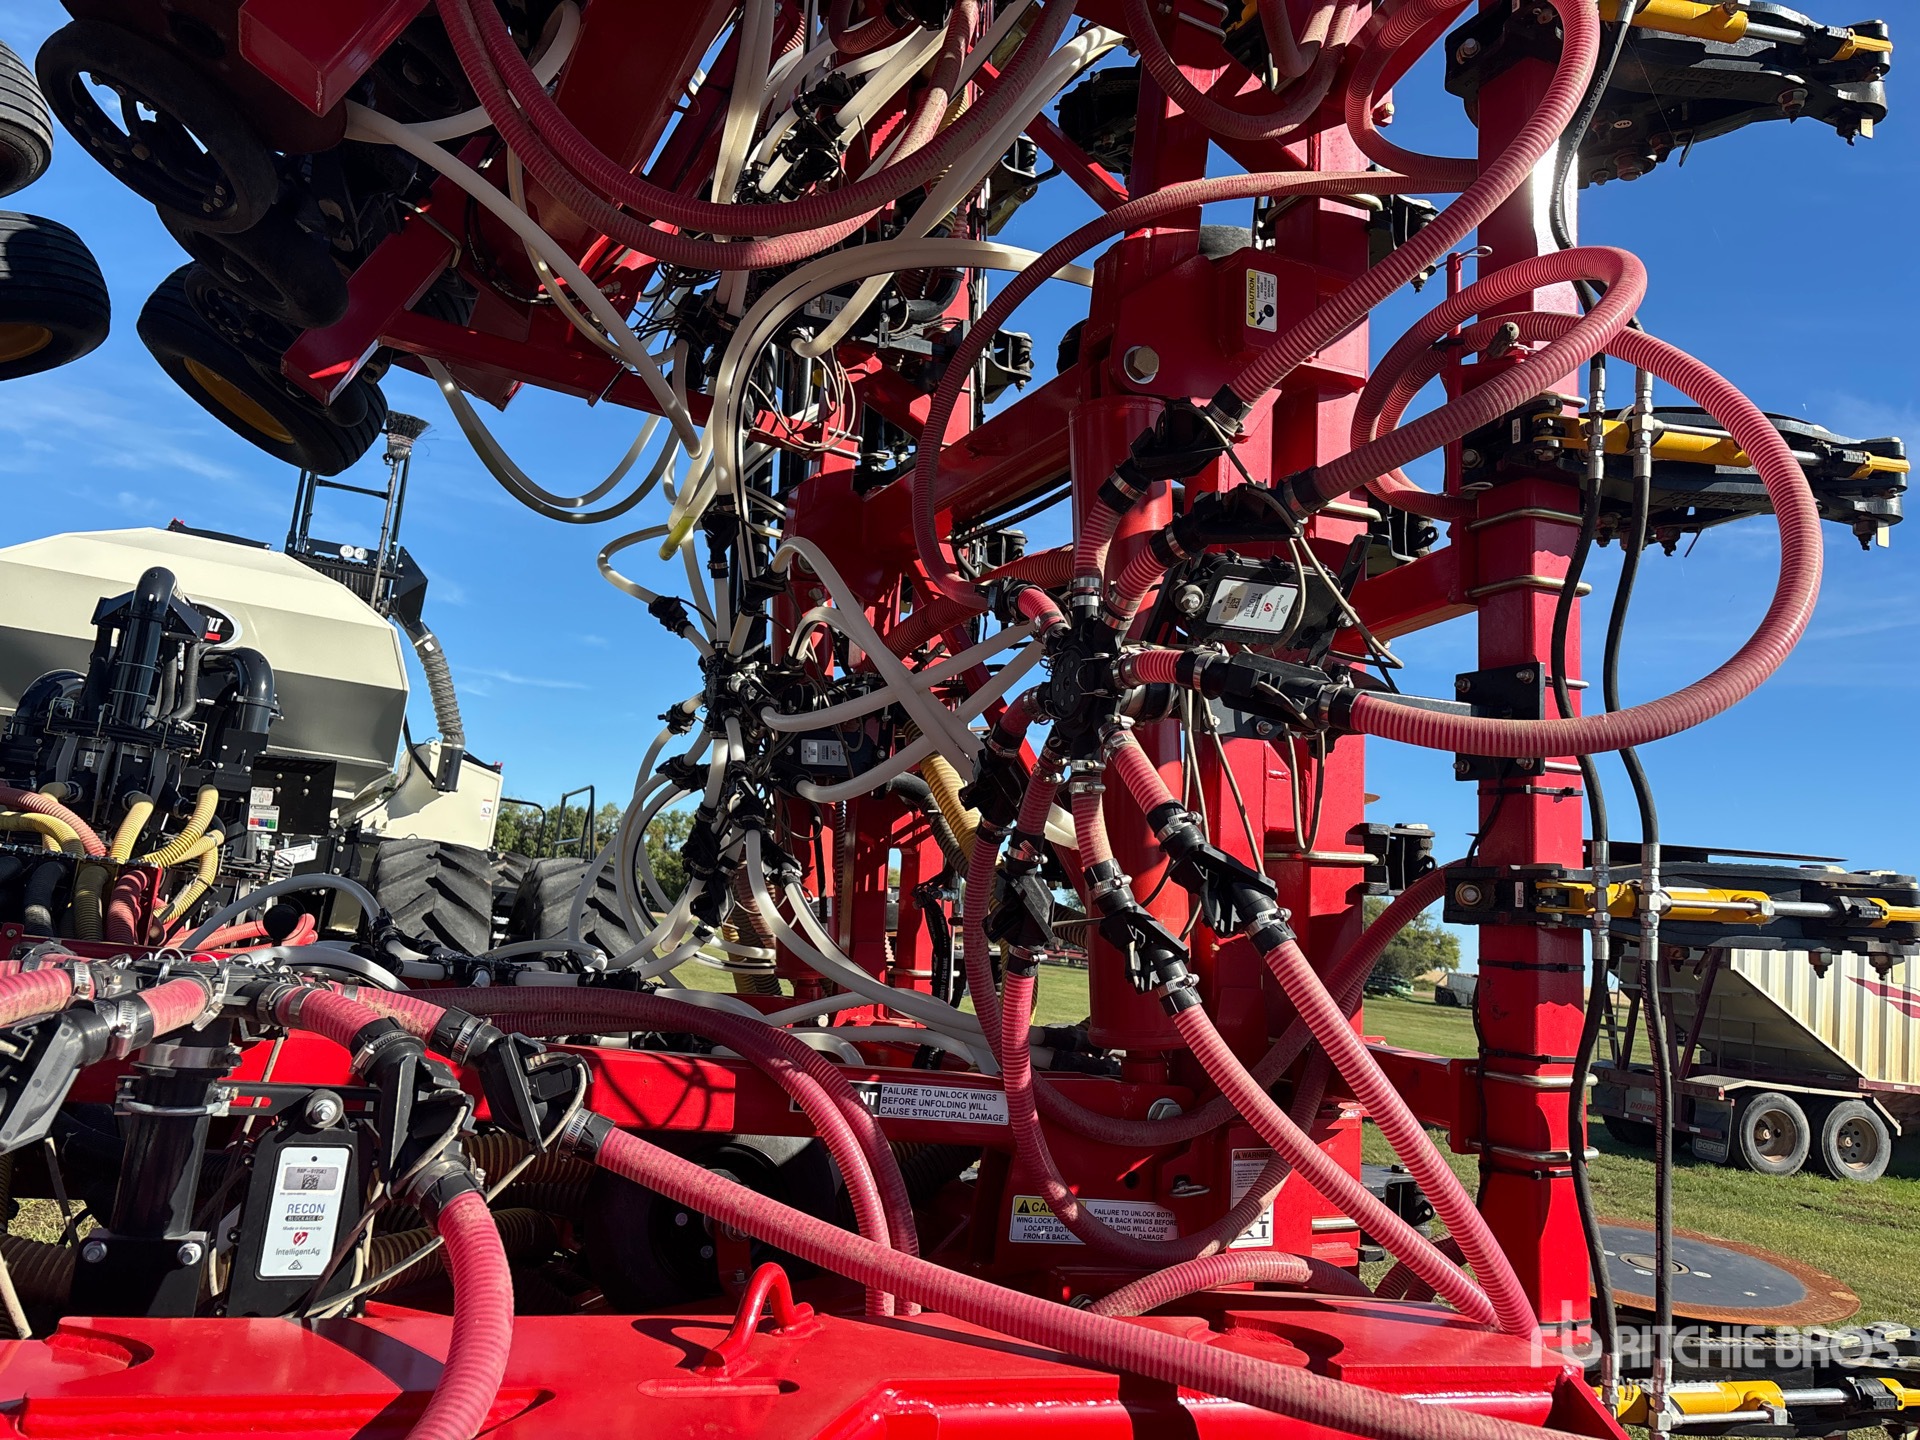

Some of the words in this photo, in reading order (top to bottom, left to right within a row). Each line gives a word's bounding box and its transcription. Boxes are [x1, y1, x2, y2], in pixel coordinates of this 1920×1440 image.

[1244, 592, 1259, 617] RECON
[882, 1086, 918, 1096] FAILURE
[921, 1089, 932, 1097] TO
[934, 1090, 968, 1100] UNLOCK
[970, 1093, 997, 1102] WINGS
[881, 1096, 916, 1106] BEFORE
[918, 1099, 967, 1110] UNFOLDING
[968, 1102, 988, 1111] WILL
[880, 1106, 910, 1116] CAUSE
[912, 1109, 967, 1120] STRUCTURAL
[969, 1113, 1007, 1122] DAMAGE.
[1697, 1141, 1725, 1153] DOEPKER
[287, 1203, 326, 1214] RECON
[1094, 1208, 1120, 1216] FAILURE
[1133, 1217, 1153, 1225] WINGS
